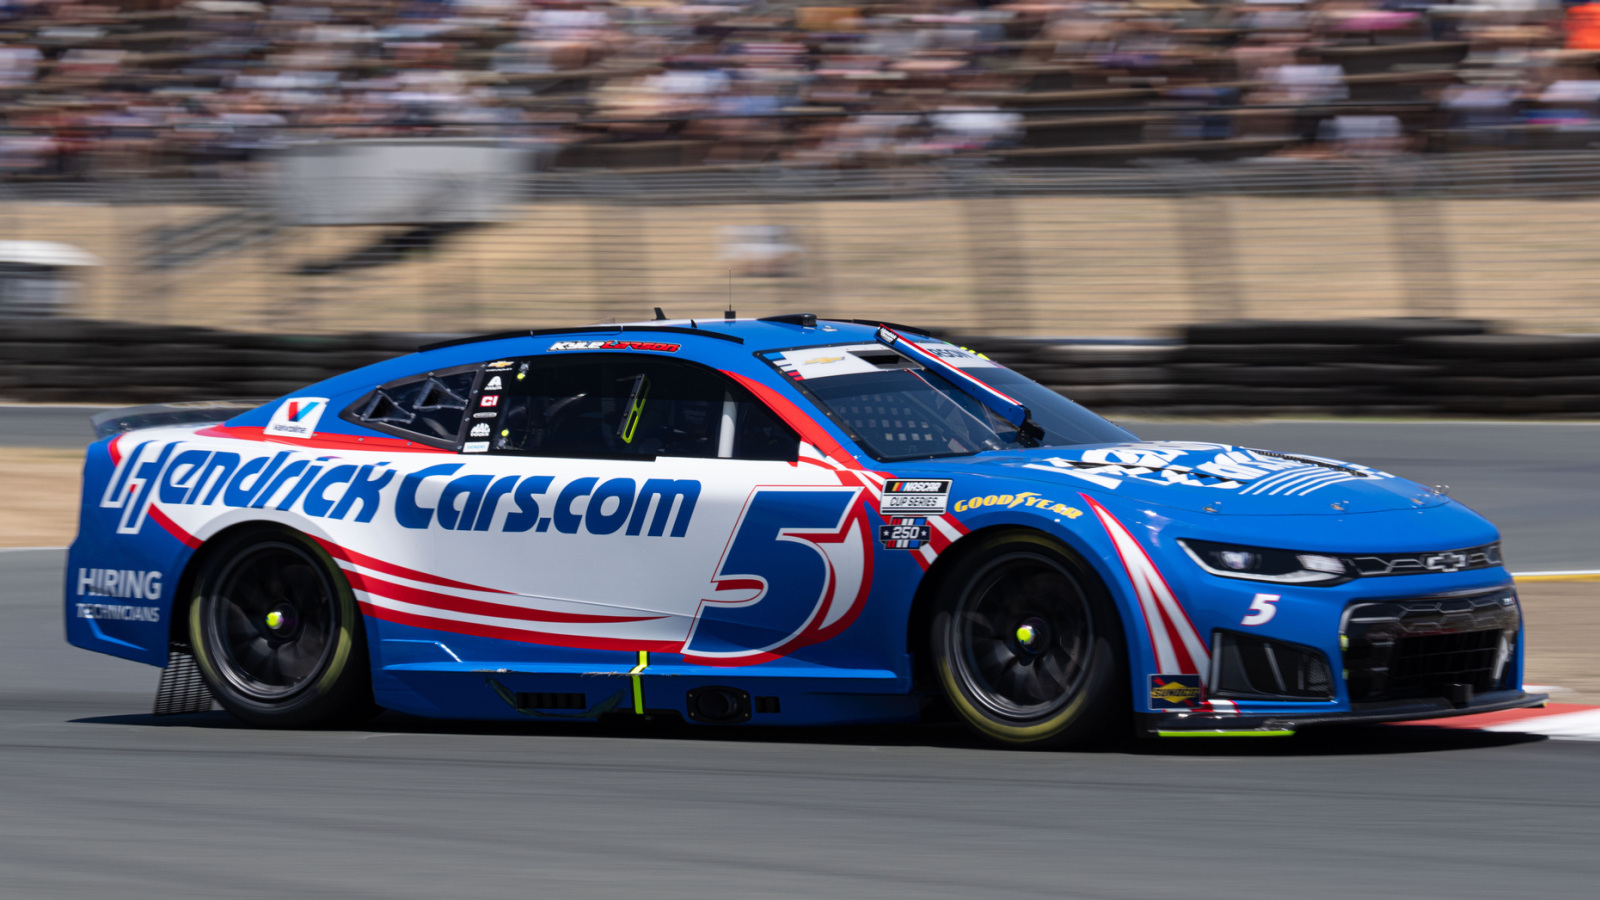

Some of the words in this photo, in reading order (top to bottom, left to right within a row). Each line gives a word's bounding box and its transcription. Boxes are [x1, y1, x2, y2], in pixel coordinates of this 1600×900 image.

[903, 482, 942, 492] NASCAR
[890, 497, 908, 506] CUP
[908, 497, 938, 506] SERIES
[954, 492, 1083, 519] GOODYEAR
[891, 526, 920, 539] 250
[76, 567, 163, 600] HIRING
[680, 484, 870, 661] 5
[75, 602, 161, 623] TECHNICIANS
[1240, 593, 1281, 626] 5
